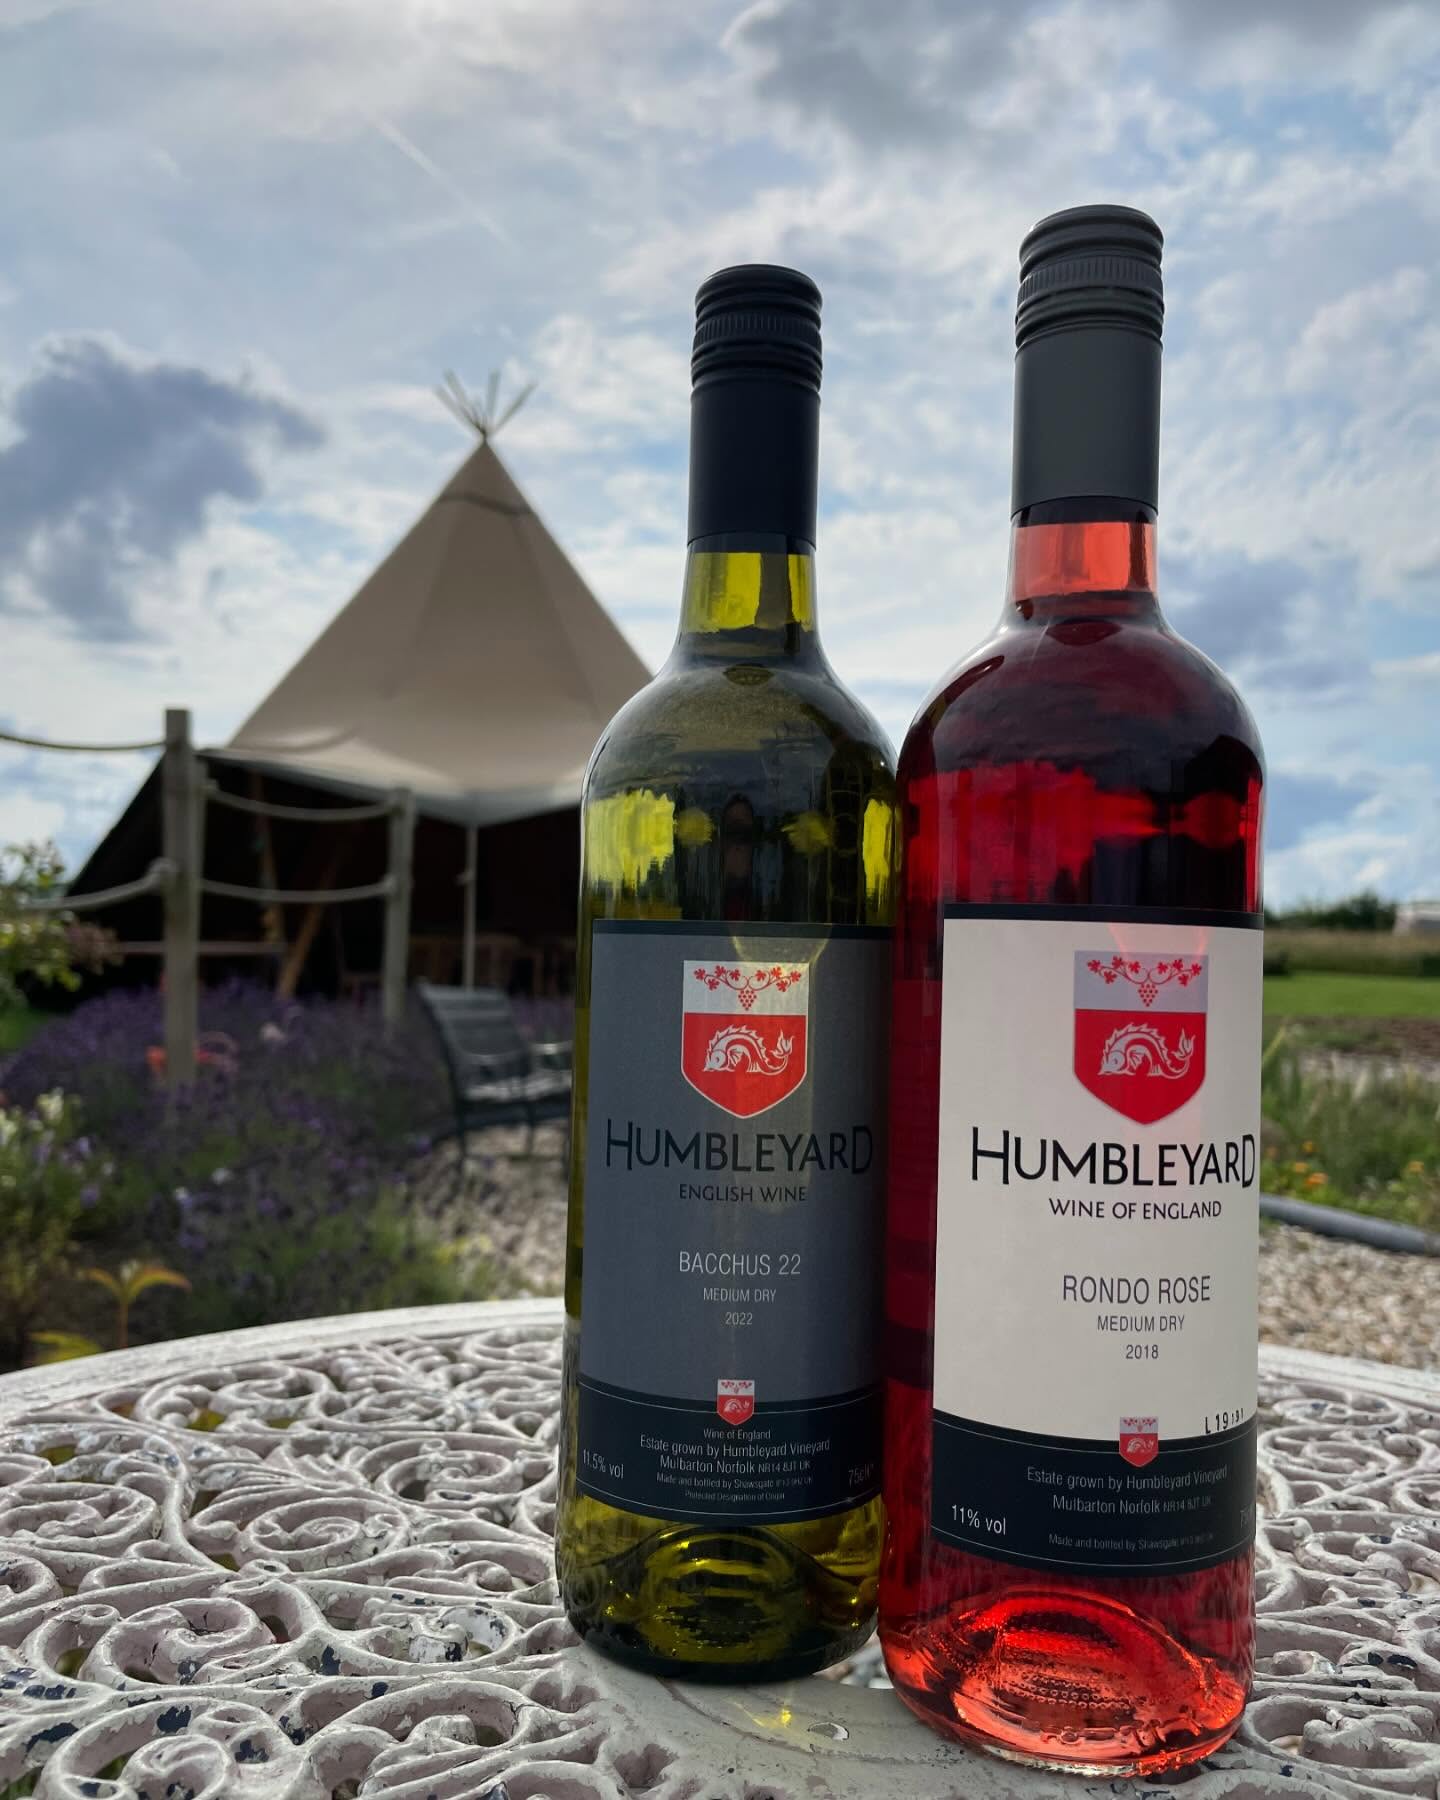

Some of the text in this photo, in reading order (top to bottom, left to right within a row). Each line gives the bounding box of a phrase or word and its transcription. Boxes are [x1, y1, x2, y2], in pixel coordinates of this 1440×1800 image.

[971, 1126, 1255, 1188] HUMBLEYARD
[679, 1183, 807, 1202] ENGLISH WINE
[1048, 1198, 1222, 1220] WINE OF ENGLAND
[679, 1251, 801, 1276] BACCHUS 22
[703, 1288, 776, 1302] MEDIUM DRY
[1063, 1275, 1211, 1304] RONDO ROSE
[725, 1312, 753, 1325] 2022
[1097, 1315, 1185, 1332] MEDIUM DRY
[1125, 1345, 1159, 1359] 2018
[703, 1429, 771, 1442] Wine of England
[640, 1434, 830, 1459] Estate grown by Humbleyard Vineyard
[583, 1448, 624, 1479] 11.5% vol
[660, 1455, 713, 1472] Mulbarton
[717, 1460, 755, 1473] Norfolk
[656, 1472, 676, 1483] Made
[678, 1476, 692, 1486] and
[694, 1476, 721, 1487] bottled
[722, 1478, 732, 1489] by
[1027, 1464, 1228, 1493] Estate grown by Humbleyard Vineyard
[1053, 1494, 1116, 1513] Mulbarton
[1119, 1499, 1160, 1514] Norfolk
[951, 1504, 1006, 1535] 11% vol
[1049, 1533, 1073, 1546] Made
[1075, 1537, 1091, 1548] and
[1094, 1538, 1123, 1550] bottled
[1125, 1539, 1136, 1552] by
